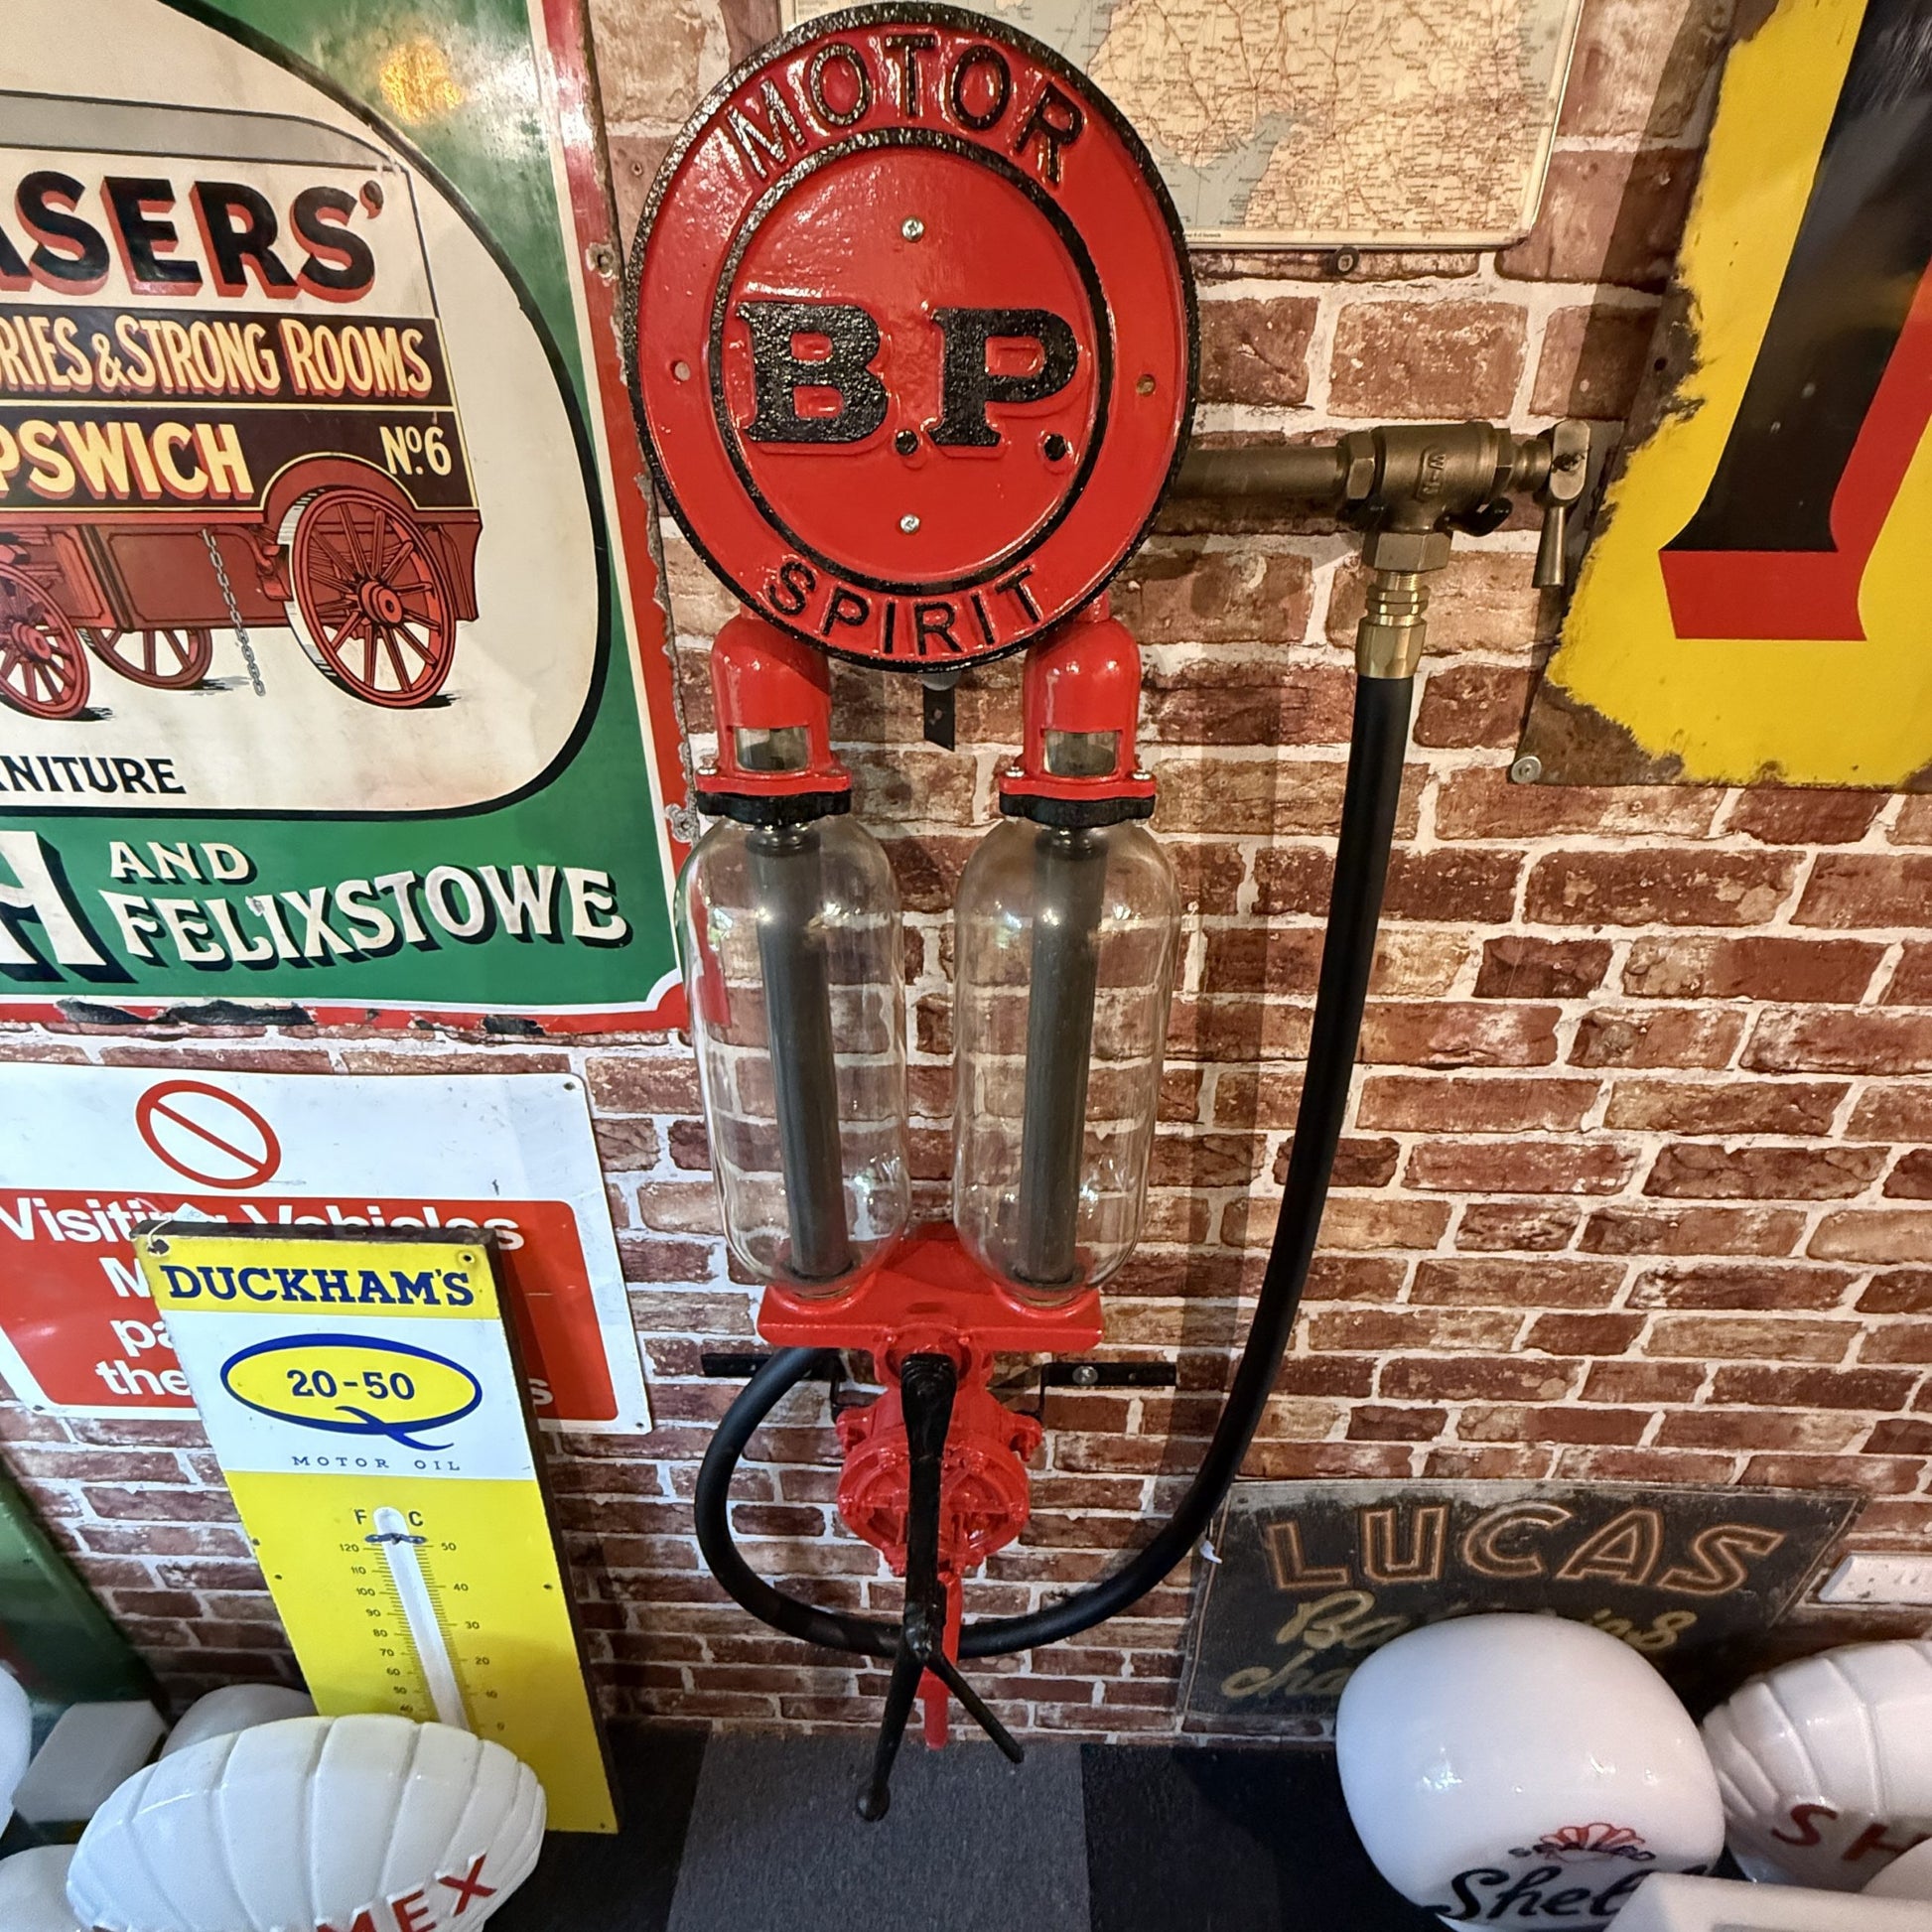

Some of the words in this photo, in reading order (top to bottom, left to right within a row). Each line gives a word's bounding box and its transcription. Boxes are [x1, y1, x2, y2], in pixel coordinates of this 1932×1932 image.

[728, 33, 1085, 187] MOTOR
[279, 319, 433, 397] ROOMS
[767, 561, 1046, 656] SPIRIT
[0, 756, 187, 794] NITURE
[108, 841, 254, 885] AND
[99, 863, 631, 968] FELIXSTOWE
[160, 1265, 475, 1307] DUCKHAM'S
[286, 1368, 415, 1400] 20-50
[292, 1455, 390, 1468] MOTOR
[414, 1459, 461, 1471] OIL
[354, 1509, 367, 1525] F
[408, 1511, 424, 1527] C
[340, 1543, 359, 1553] 120
[441, 1542, 457, 1552] 50
[1265, 1502, 1785, 1595] LUCAS
[350, 1566, 366, 1576] 110
[356, 1587, 376, 1596] 100
[454, 1583, 469, 1592] 40
[365, 1608, 381, 1617] 90
[465, 1621, 480, 1630] 30
[372, 1628, 388, 1638] 80
[380, 1648, 394, 1657] 70
[476, 1656, 489, 1666] 20
[386, 1668, 401, 1677] 60
